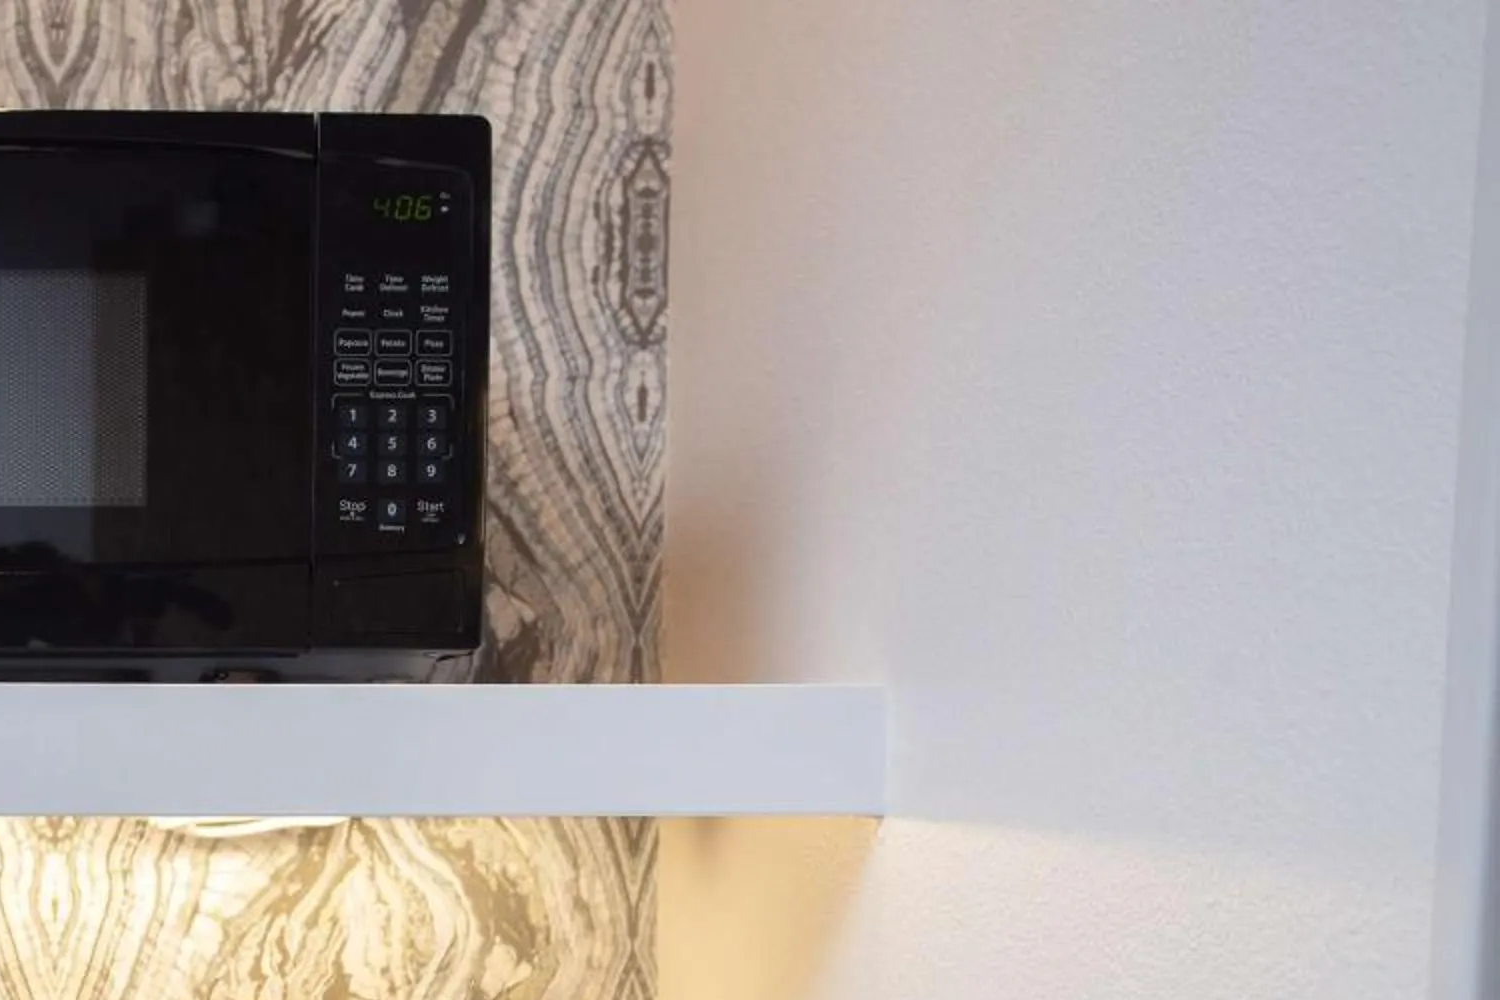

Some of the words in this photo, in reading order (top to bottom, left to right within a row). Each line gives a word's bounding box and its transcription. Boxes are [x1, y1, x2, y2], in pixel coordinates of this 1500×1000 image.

[349, 408, 357, 422] 1
[387, 409, 397, 423] 2
[427, 409, 437, 423] 3
[347, 436, 357, 449] 4
[387, 436, 397, 450] 5
[427, 437, 437, 450] 6
[348, 463, 357, 478] 7
[387, 464, 397, 477] 8
[426, 464, 437, 477] 9
[339, 500, 367, 513] Stop
[387, 502, 397, 516] 0
[417, 500, 445, 513] Start
